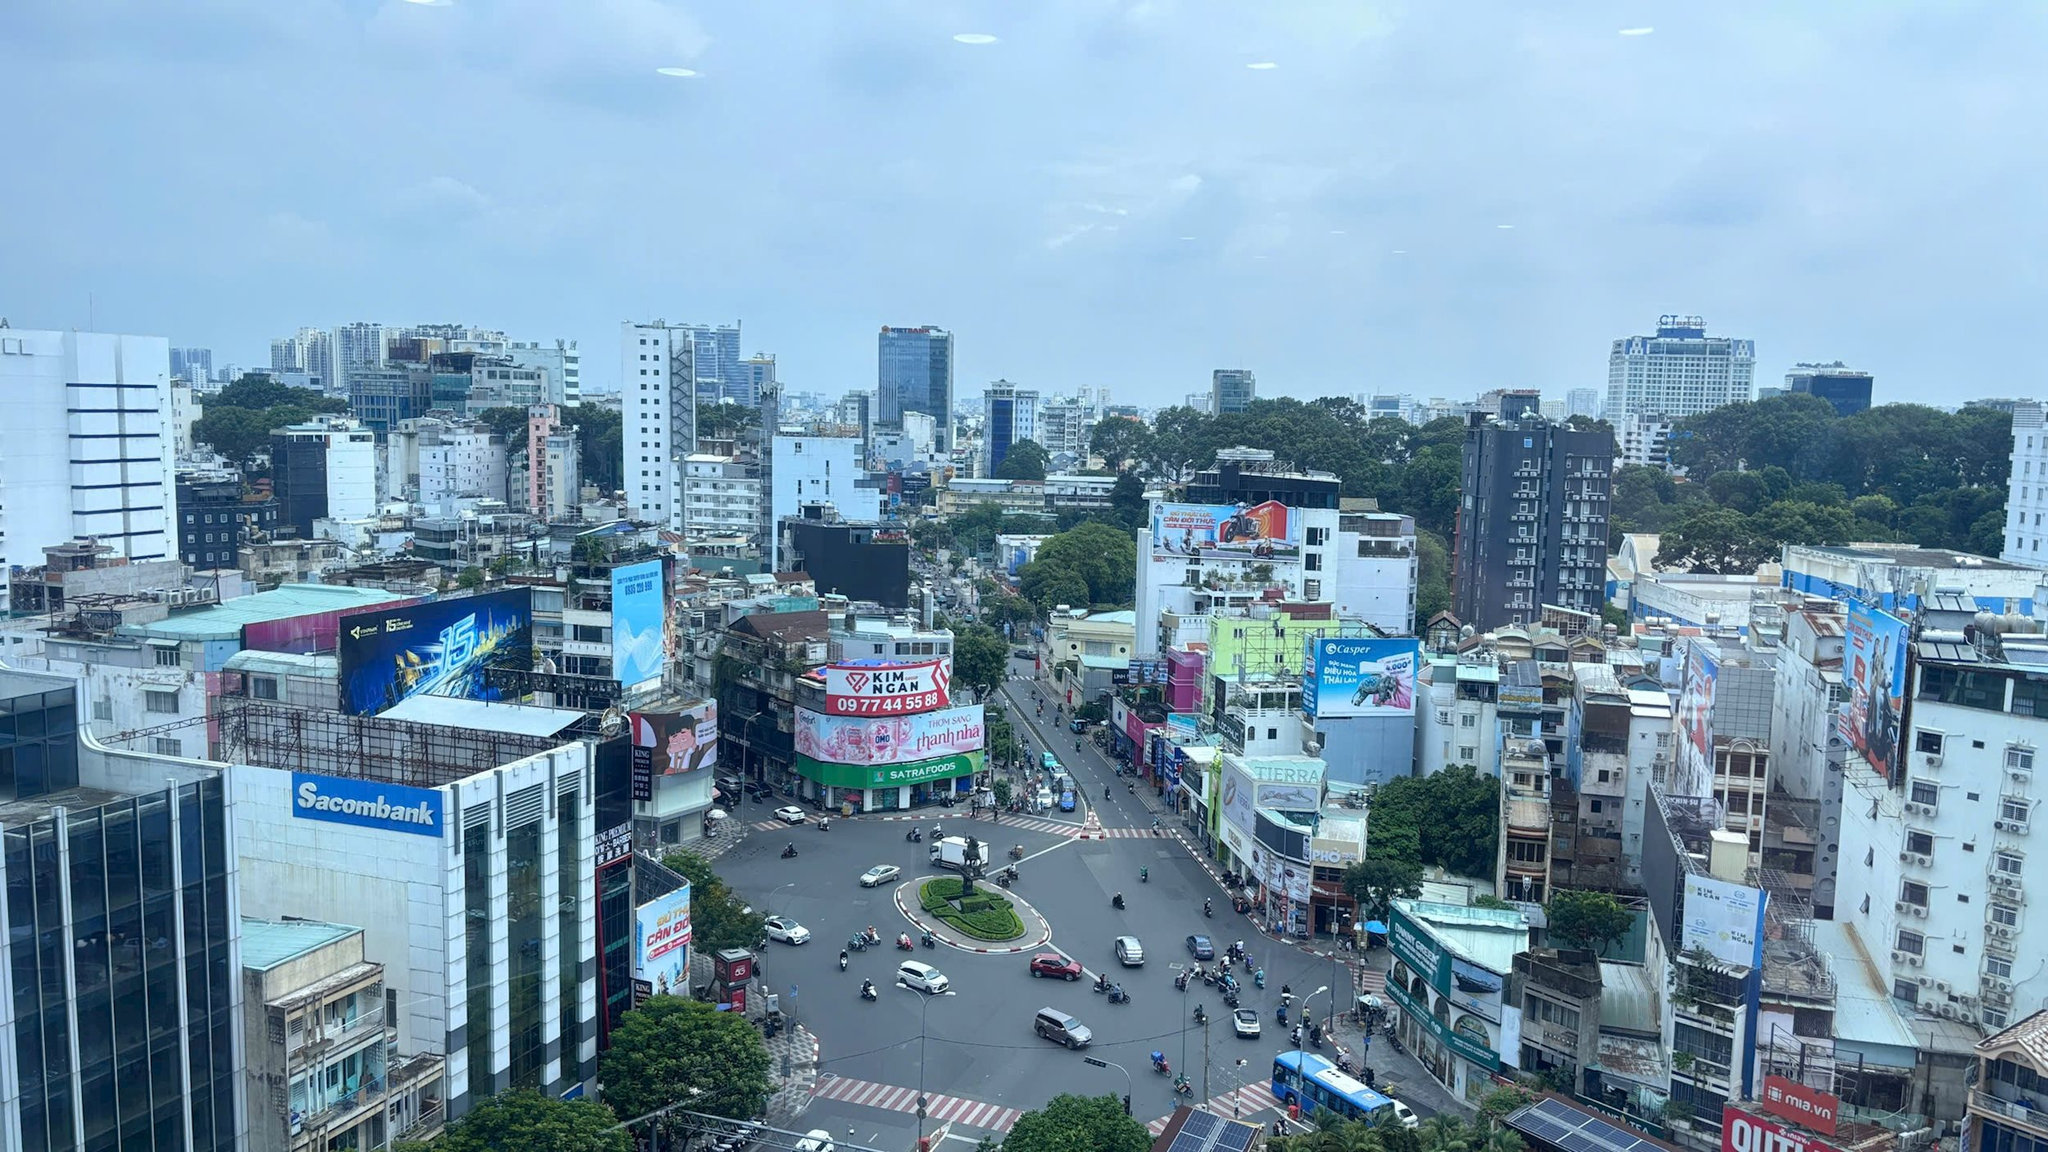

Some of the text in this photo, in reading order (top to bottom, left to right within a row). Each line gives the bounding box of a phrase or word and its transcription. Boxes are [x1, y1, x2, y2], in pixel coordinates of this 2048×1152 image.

[1659, 314, 1679, 326] CT
[439, 612, 476, 675] 15
[1337, 644, 1371, 656] Casper
[872, 671, 904, 683] KIM
[872, 681, 919, 694] NGAN
[875, 734, 890, 744] OMO
[916, 727, 956, 752] thanh
[634, 749, 650, 759] KING
[1255, 765, 1320, 783] TIERRA
[297, 781, 434, 825] Sacombank
[1697, 886, 1713, 895] KIM
[1785, 1094, 1832, 1120] mia.vn
